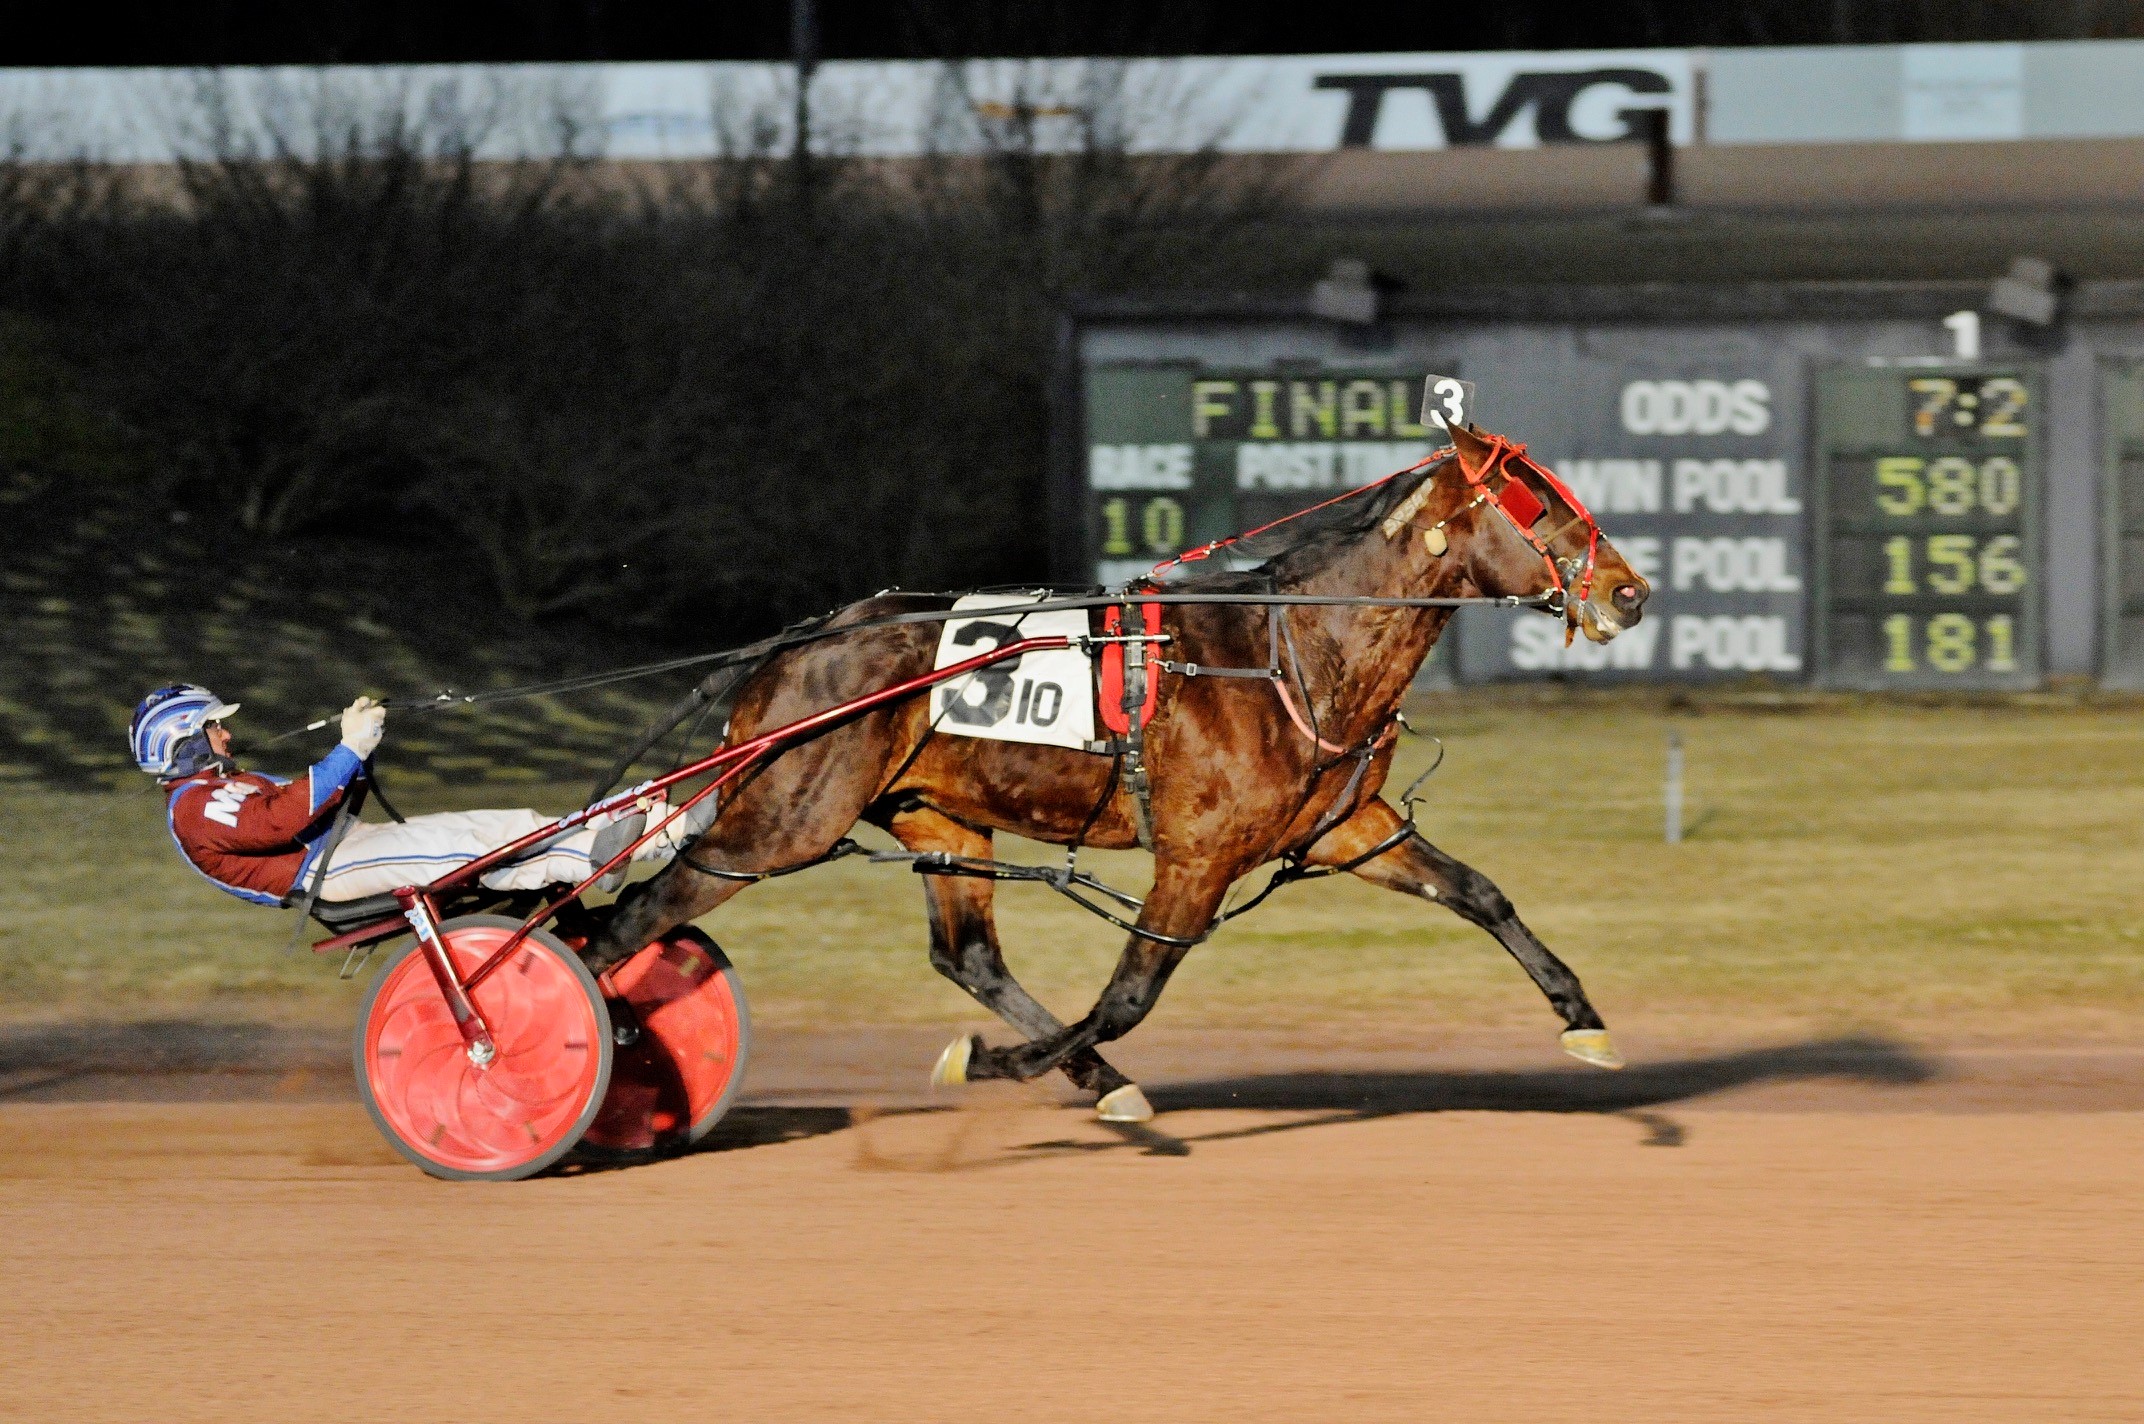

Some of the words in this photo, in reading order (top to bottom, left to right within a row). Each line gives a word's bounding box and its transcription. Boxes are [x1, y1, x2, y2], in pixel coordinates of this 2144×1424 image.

[1315, 69, 1672, 147] TVG
[1944, 311, 1979, 358] 1
[1192, 381, 1429, 438] FINAL
[1430, 380, 1463, 429] 3
[1622, 380, 1770, 435] ODDS
[1908, 378, 2028, 436] 7:2
[1555, 459, 1661, 512] WIN
[1673, 459, 1800, 513] POOL
[1876, 457, 2020, 515] 580
[1102, 498, 1184, 554] 10
[1673, 537, 1800, 591] POOL
[1883, 535, 2028, 594] 156
[1673, 616, 1800, 670] POOL
[1884, 613, 2017, 672] 181
[940, 620, 1025, 728] 3
[1015, 678, 1063, 726] 10
